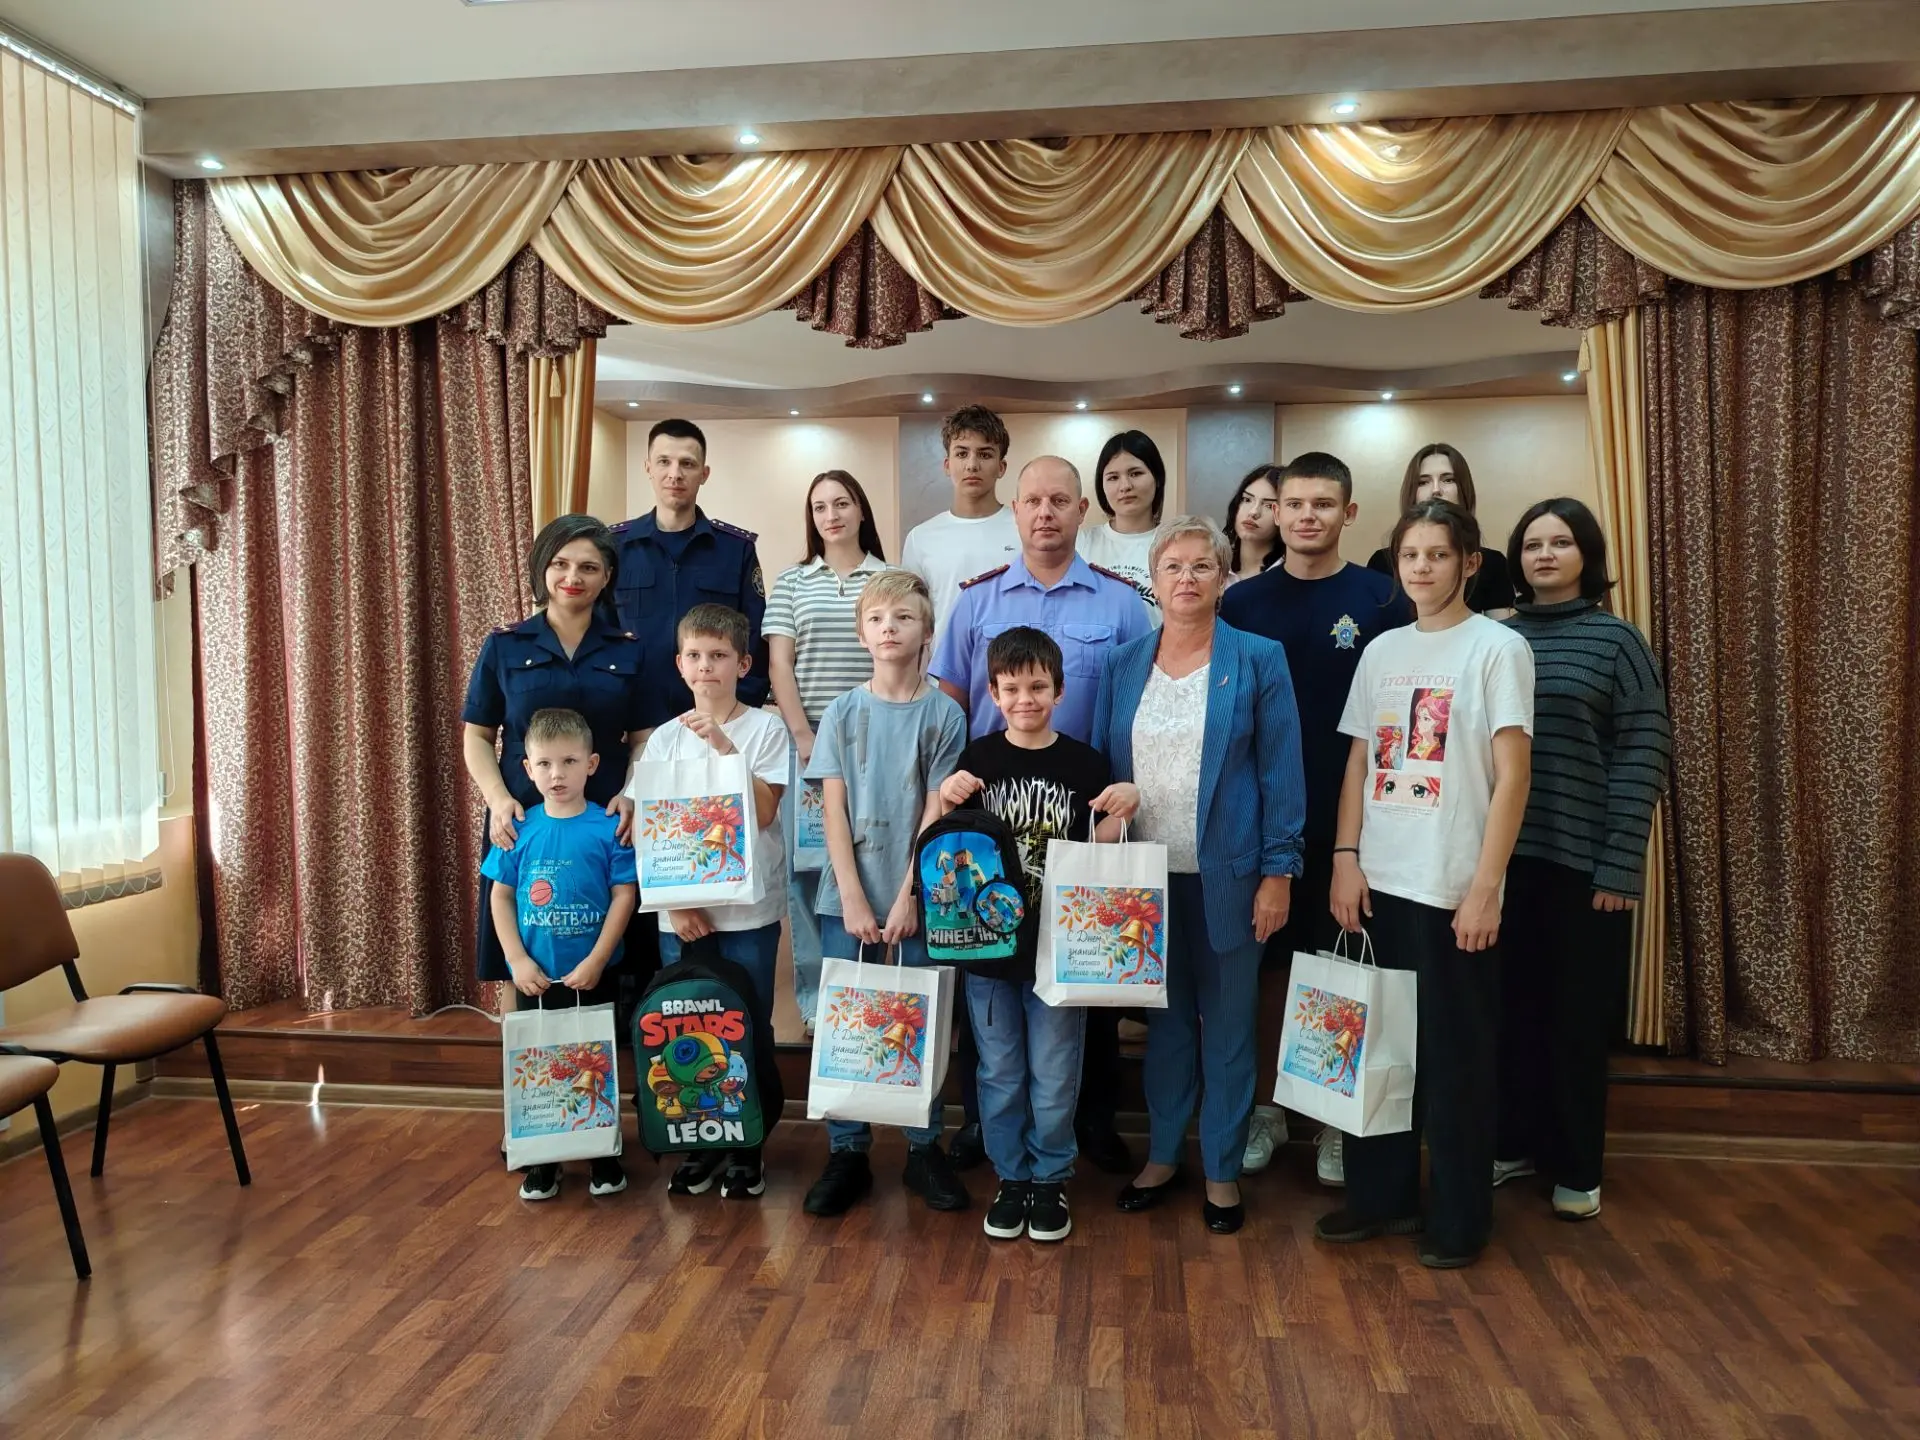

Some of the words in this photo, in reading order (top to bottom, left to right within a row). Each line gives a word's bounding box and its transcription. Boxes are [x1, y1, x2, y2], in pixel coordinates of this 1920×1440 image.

[661, 999, 725, 1015] BRAWL
[640, 1011, 745, 1047] STARS
[667, 1119, 745, 1144] LEON
